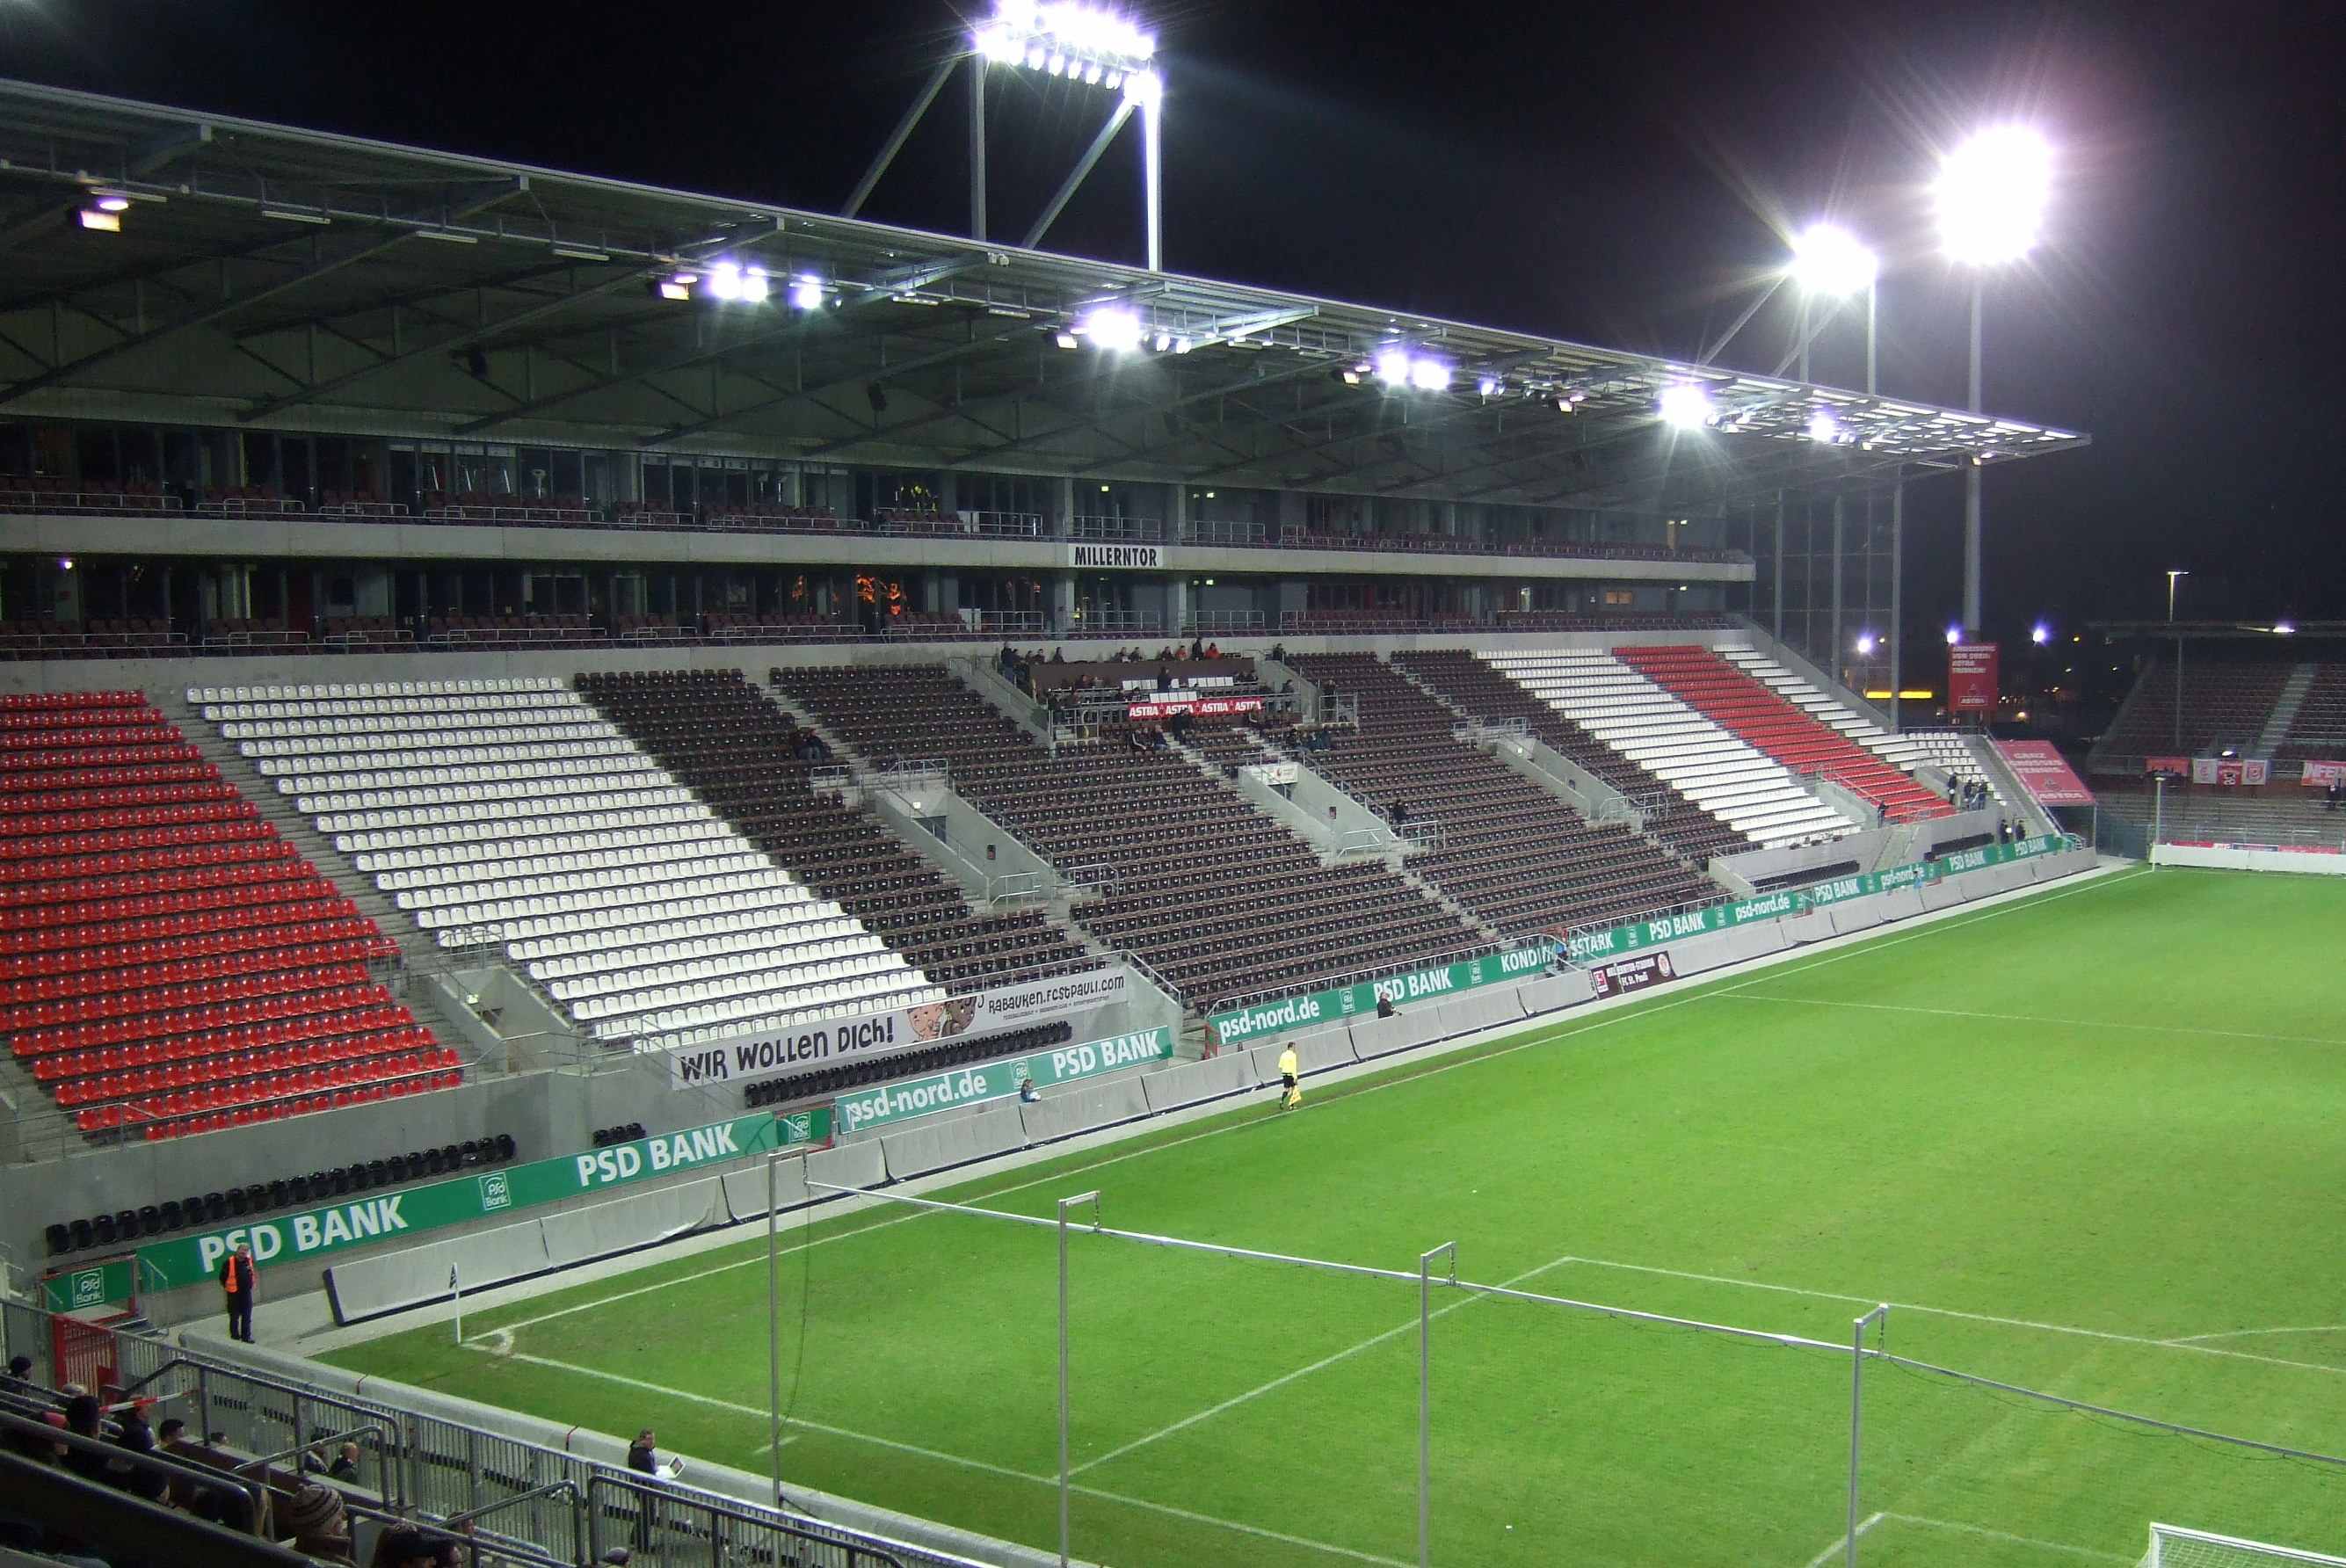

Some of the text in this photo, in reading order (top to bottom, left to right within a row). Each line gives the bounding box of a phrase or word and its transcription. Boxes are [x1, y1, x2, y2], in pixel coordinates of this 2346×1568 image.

[1074, 546, 1158, 567] MILLERNTOR
[1129, 706, 1158, 717] ASTRA
[1202, 702, 1229, 713] ASTRA
[1814, 883, 1833, 903] PSD
[1833, 877, 1860, 897] BANK
[1735, 892, 1790, 922] psd-nord.de
[1649, 918, 1672, 941] PSD
[1673, 911, 1705, 935] BANK
[1373, 977, 1405, 1003] PSD
[1407, 967, 1453, 997] BANK
[1219, 996, 1319, 1044] psd-nord.de
[680, 1049, 729, 1083] WIR
[1052, 1030, 1163, 1078] PSD BANK
[845, 1071, 986, 1129] psd-nord.de
[577, 1122, 739, 1187] PSD BANK
[485, 1194, 508, 1207] Bank
[200, 1195, 408, 1273] PSD BANK
[76, 1290, 105, 1304] Bank
